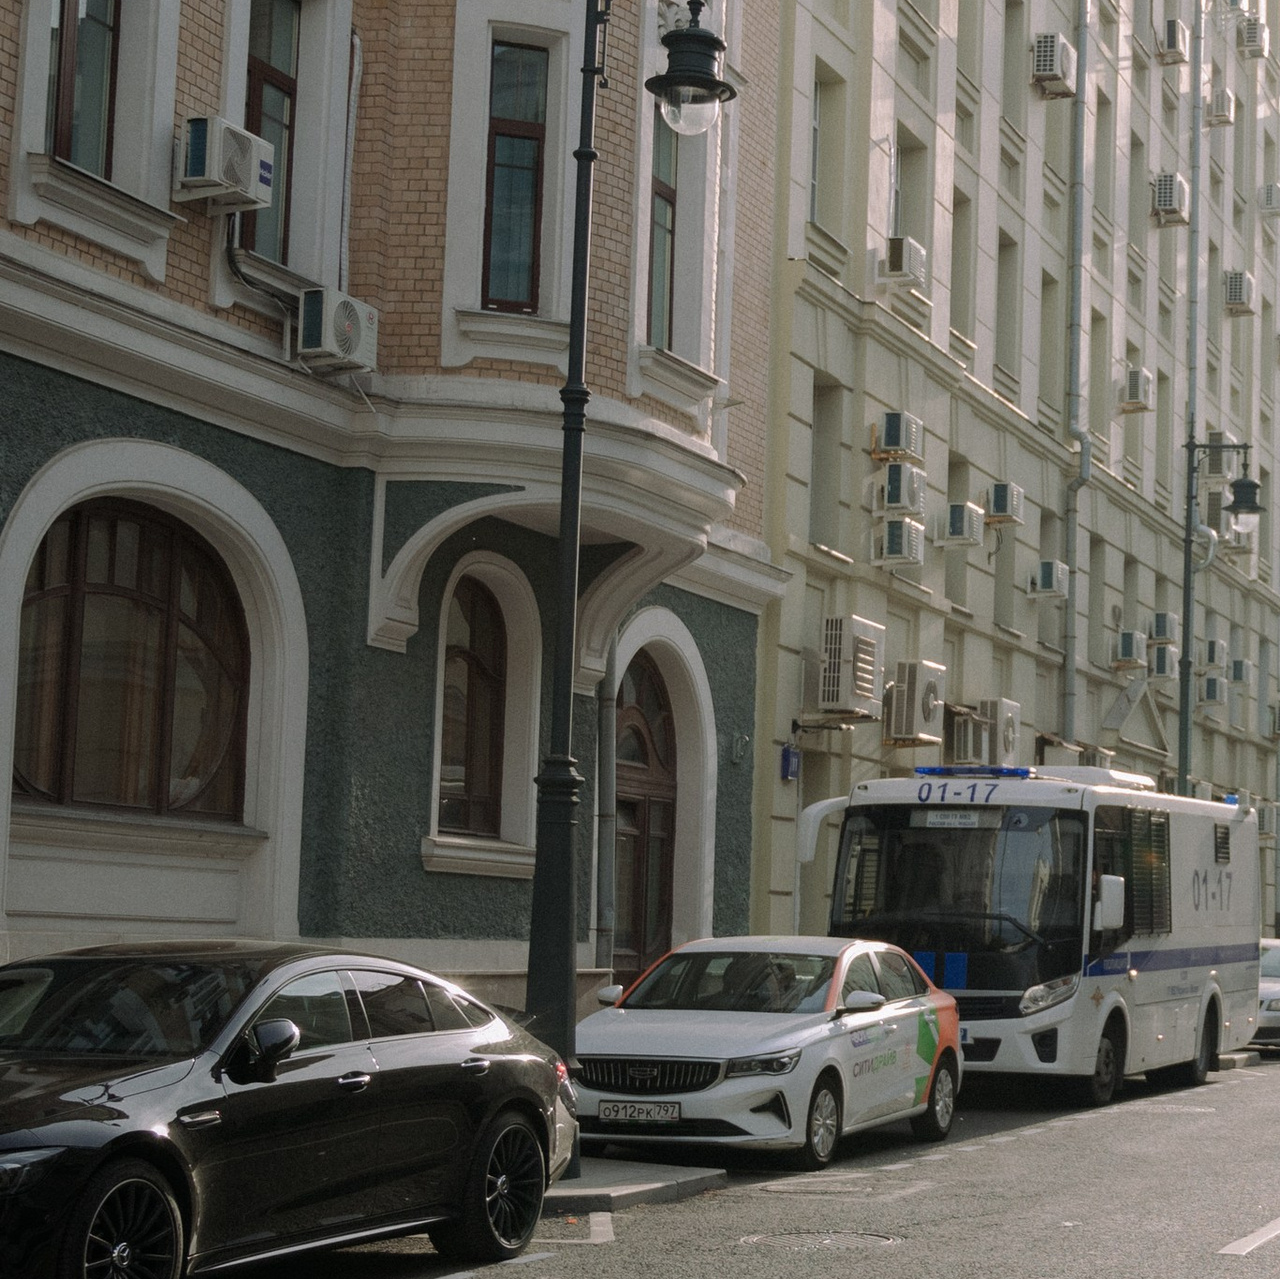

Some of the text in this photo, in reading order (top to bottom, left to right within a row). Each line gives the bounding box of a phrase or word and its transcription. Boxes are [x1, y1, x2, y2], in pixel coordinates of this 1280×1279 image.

[918, 782, 999, 803] 01-17
[1192, 869, 1232, 912] 01-17
[853, 1048, 897, 1078] СИТИДРАЙВ
